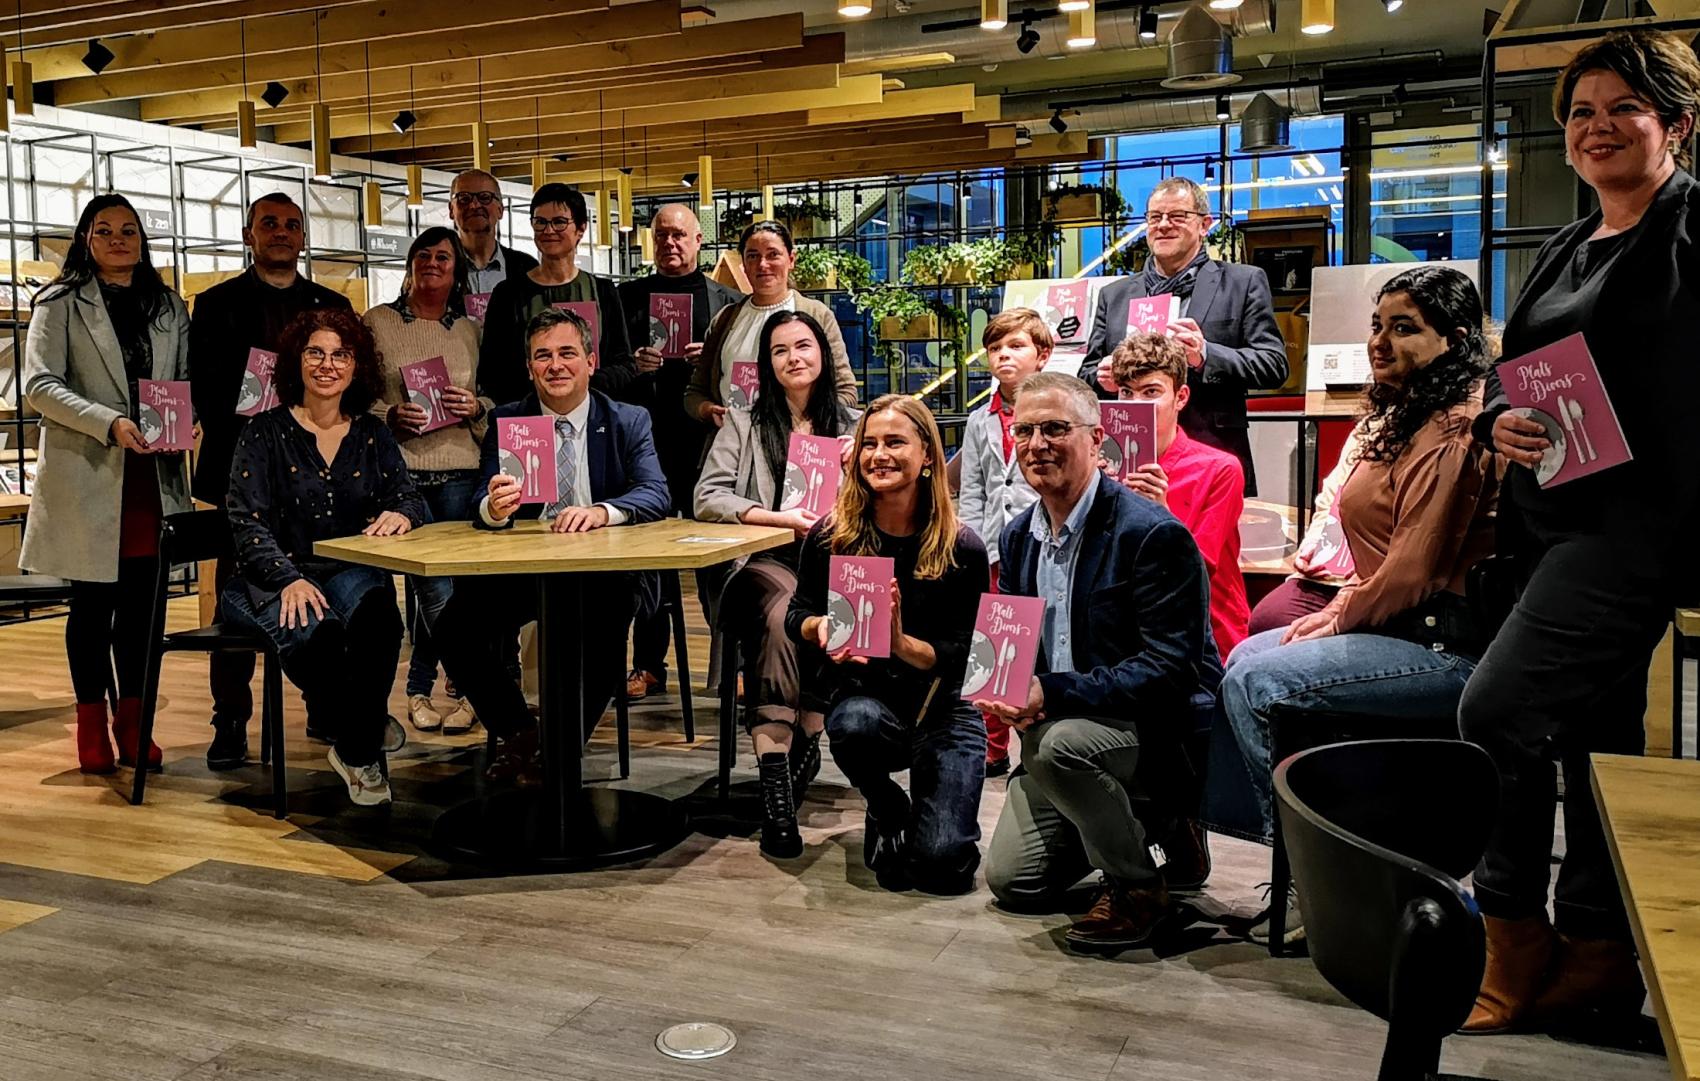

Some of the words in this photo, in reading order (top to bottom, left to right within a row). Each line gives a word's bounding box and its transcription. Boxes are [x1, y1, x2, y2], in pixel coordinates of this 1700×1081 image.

[1516, 361, 1552, 391] Plats
[1106, 407, 1132, 424] Plats
[506, 423, 531, 440] Plats
[839, 562, 867, 581] Plats
[987, 601, 1016, 621] Plats
